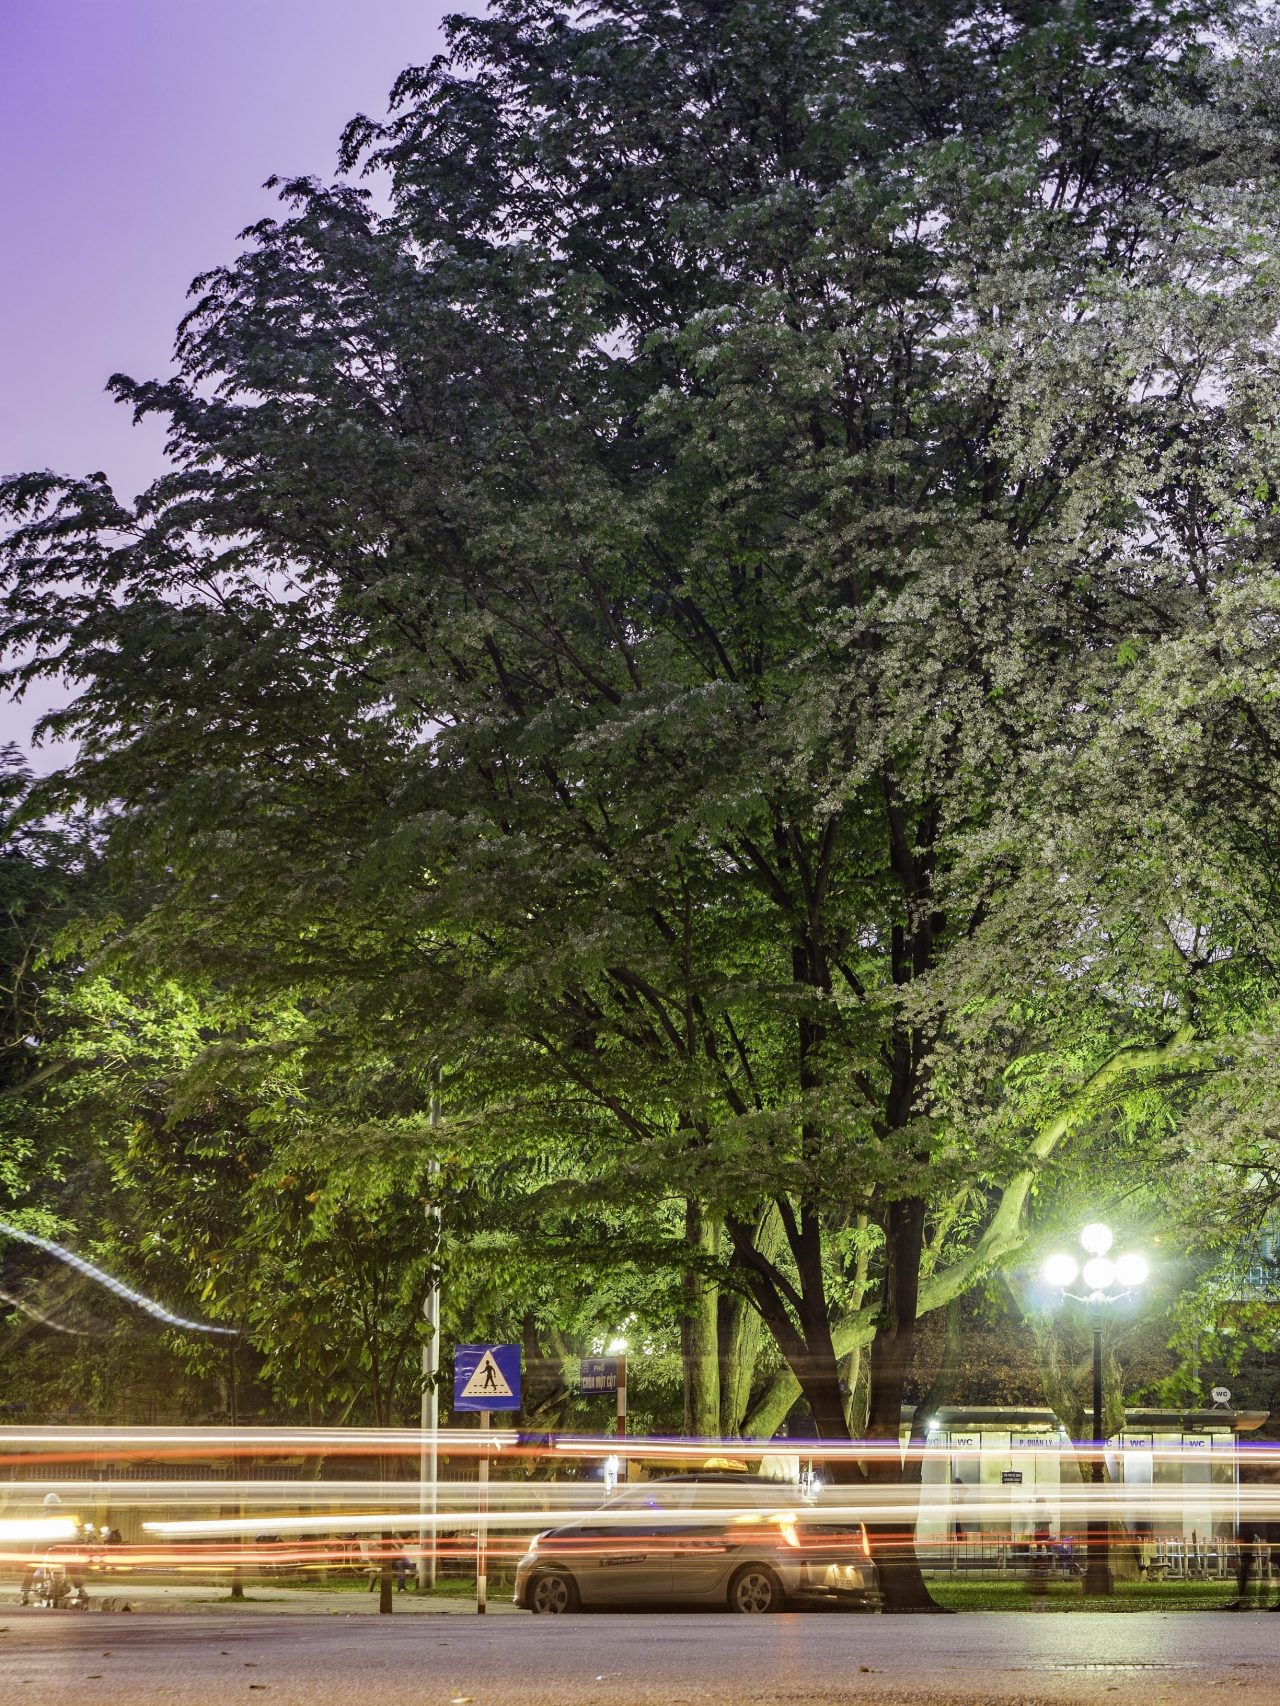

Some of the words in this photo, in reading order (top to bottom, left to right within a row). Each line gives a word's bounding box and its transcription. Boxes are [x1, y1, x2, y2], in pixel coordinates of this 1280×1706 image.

[957, 1438, 973, 1446] WC
[1130, 1439, 1145, 1447] WC
[1190, 1440, 1205, 1448] WC
